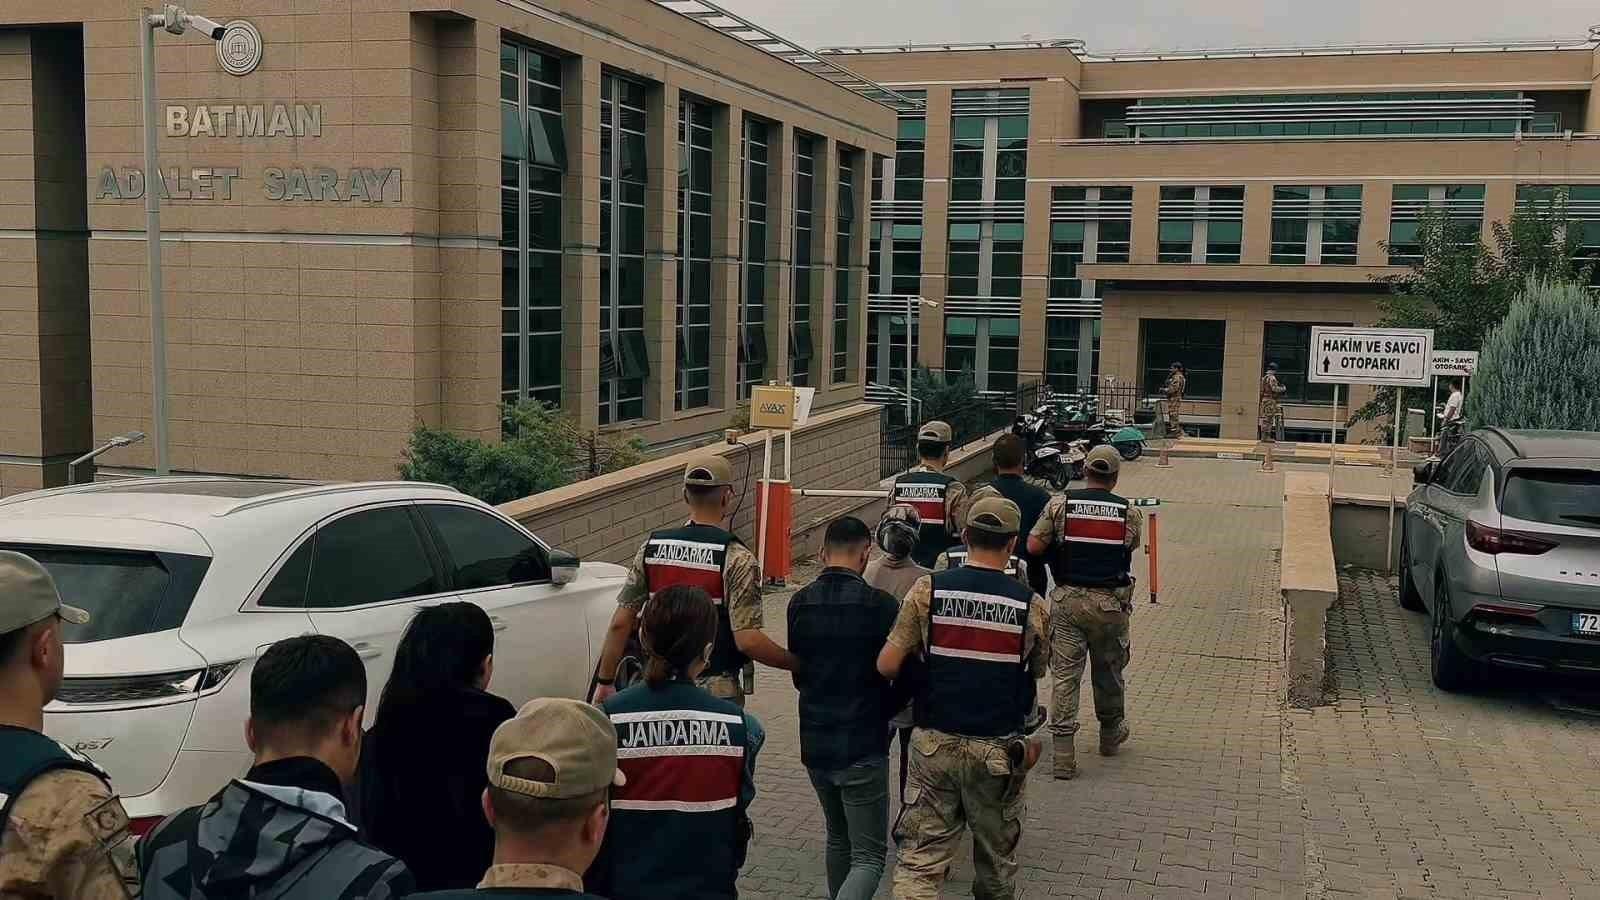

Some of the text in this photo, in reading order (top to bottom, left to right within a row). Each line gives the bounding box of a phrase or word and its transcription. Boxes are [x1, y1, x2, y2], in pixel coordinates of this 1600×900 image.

[165, 104, 321, 138] BATMAN
[263, 167, 402, 203] SARAYI
[1323, 338, 1420, 354] HAKİM VE SAVCI
[1341, 356, 1401, 370] OTOPARKI
[899, 486, 940, 499] JANDARMA
[1071, 504, 1119, 518] JANDARMA
[653, 543, 715, 565] JANDARMA
[937, 597, 1020, 625] JANDARMA
[1580, 614, 1598, 631] 72
[621, 719, 732, 747] JANDARMA
